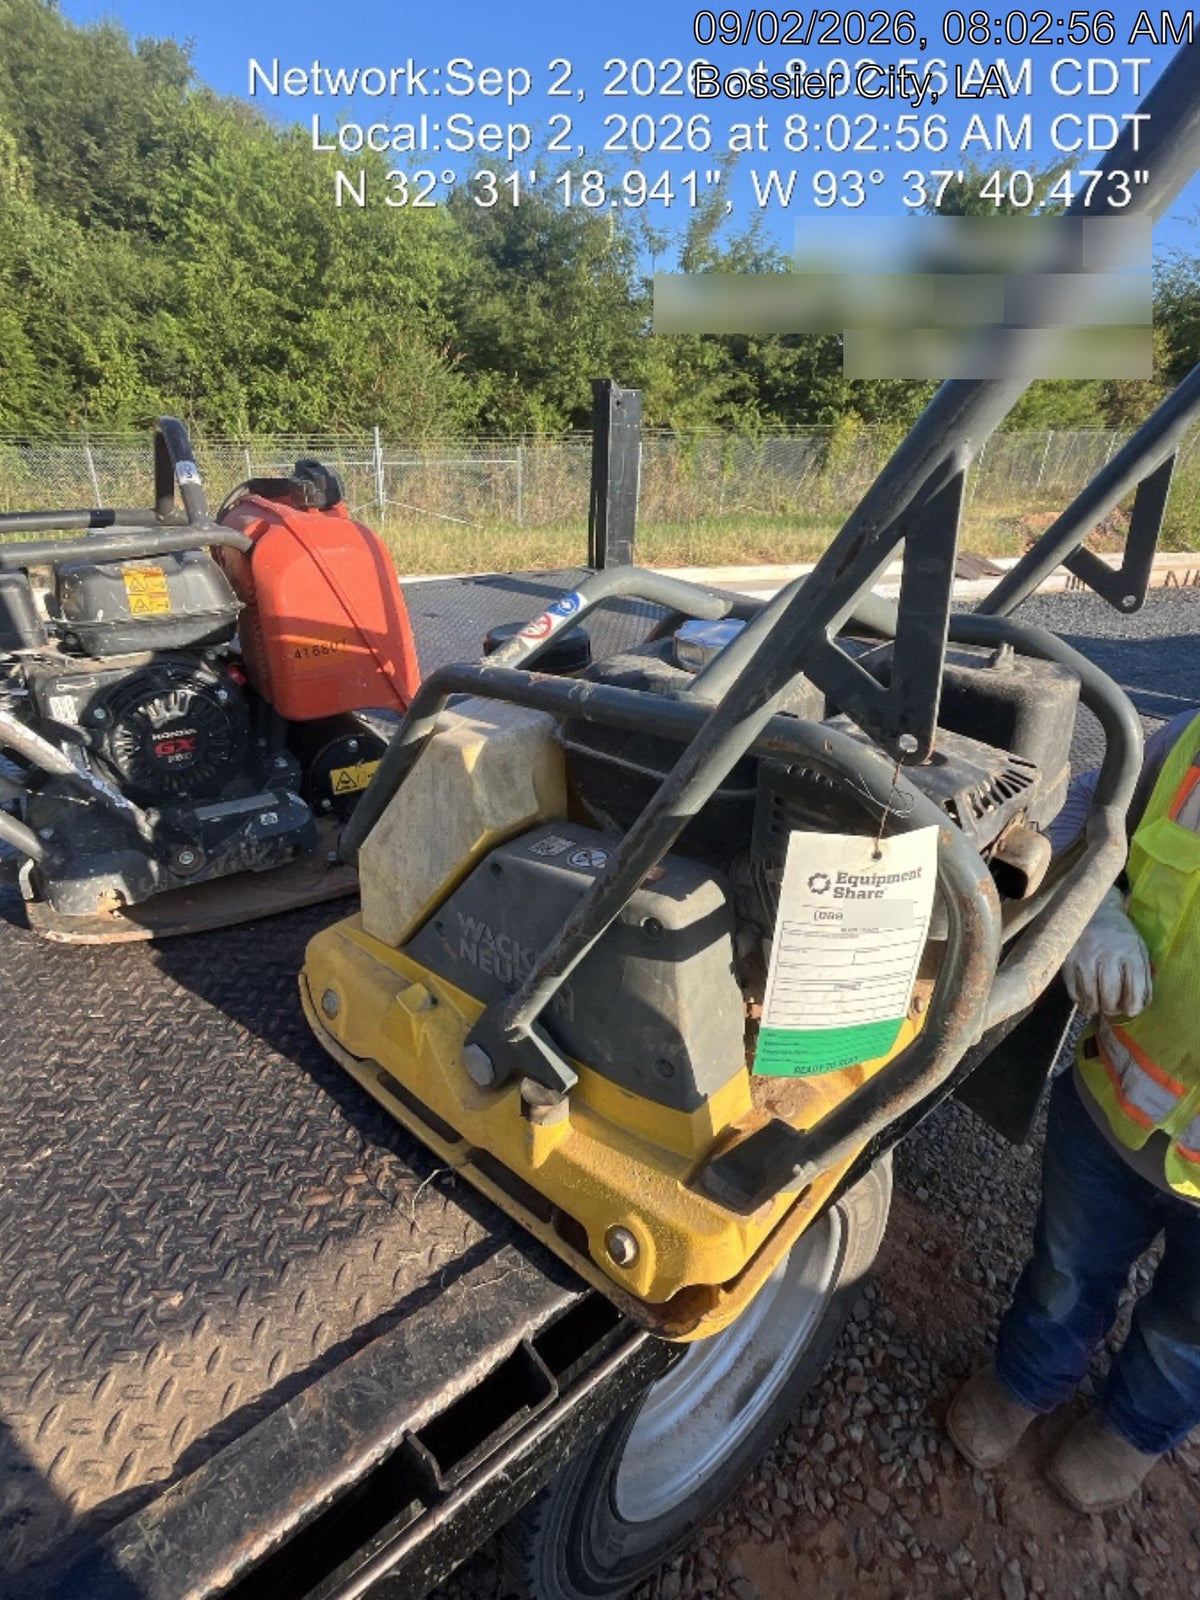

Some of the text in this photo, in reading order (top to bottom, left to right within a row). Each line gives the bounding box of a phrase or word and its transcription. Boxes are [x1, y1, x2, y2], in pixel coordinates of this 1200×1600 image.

[155, 739, 197, 756] GX
[835, 866, 923, 888] Equipment
[833, 886, 885, 900] Share
